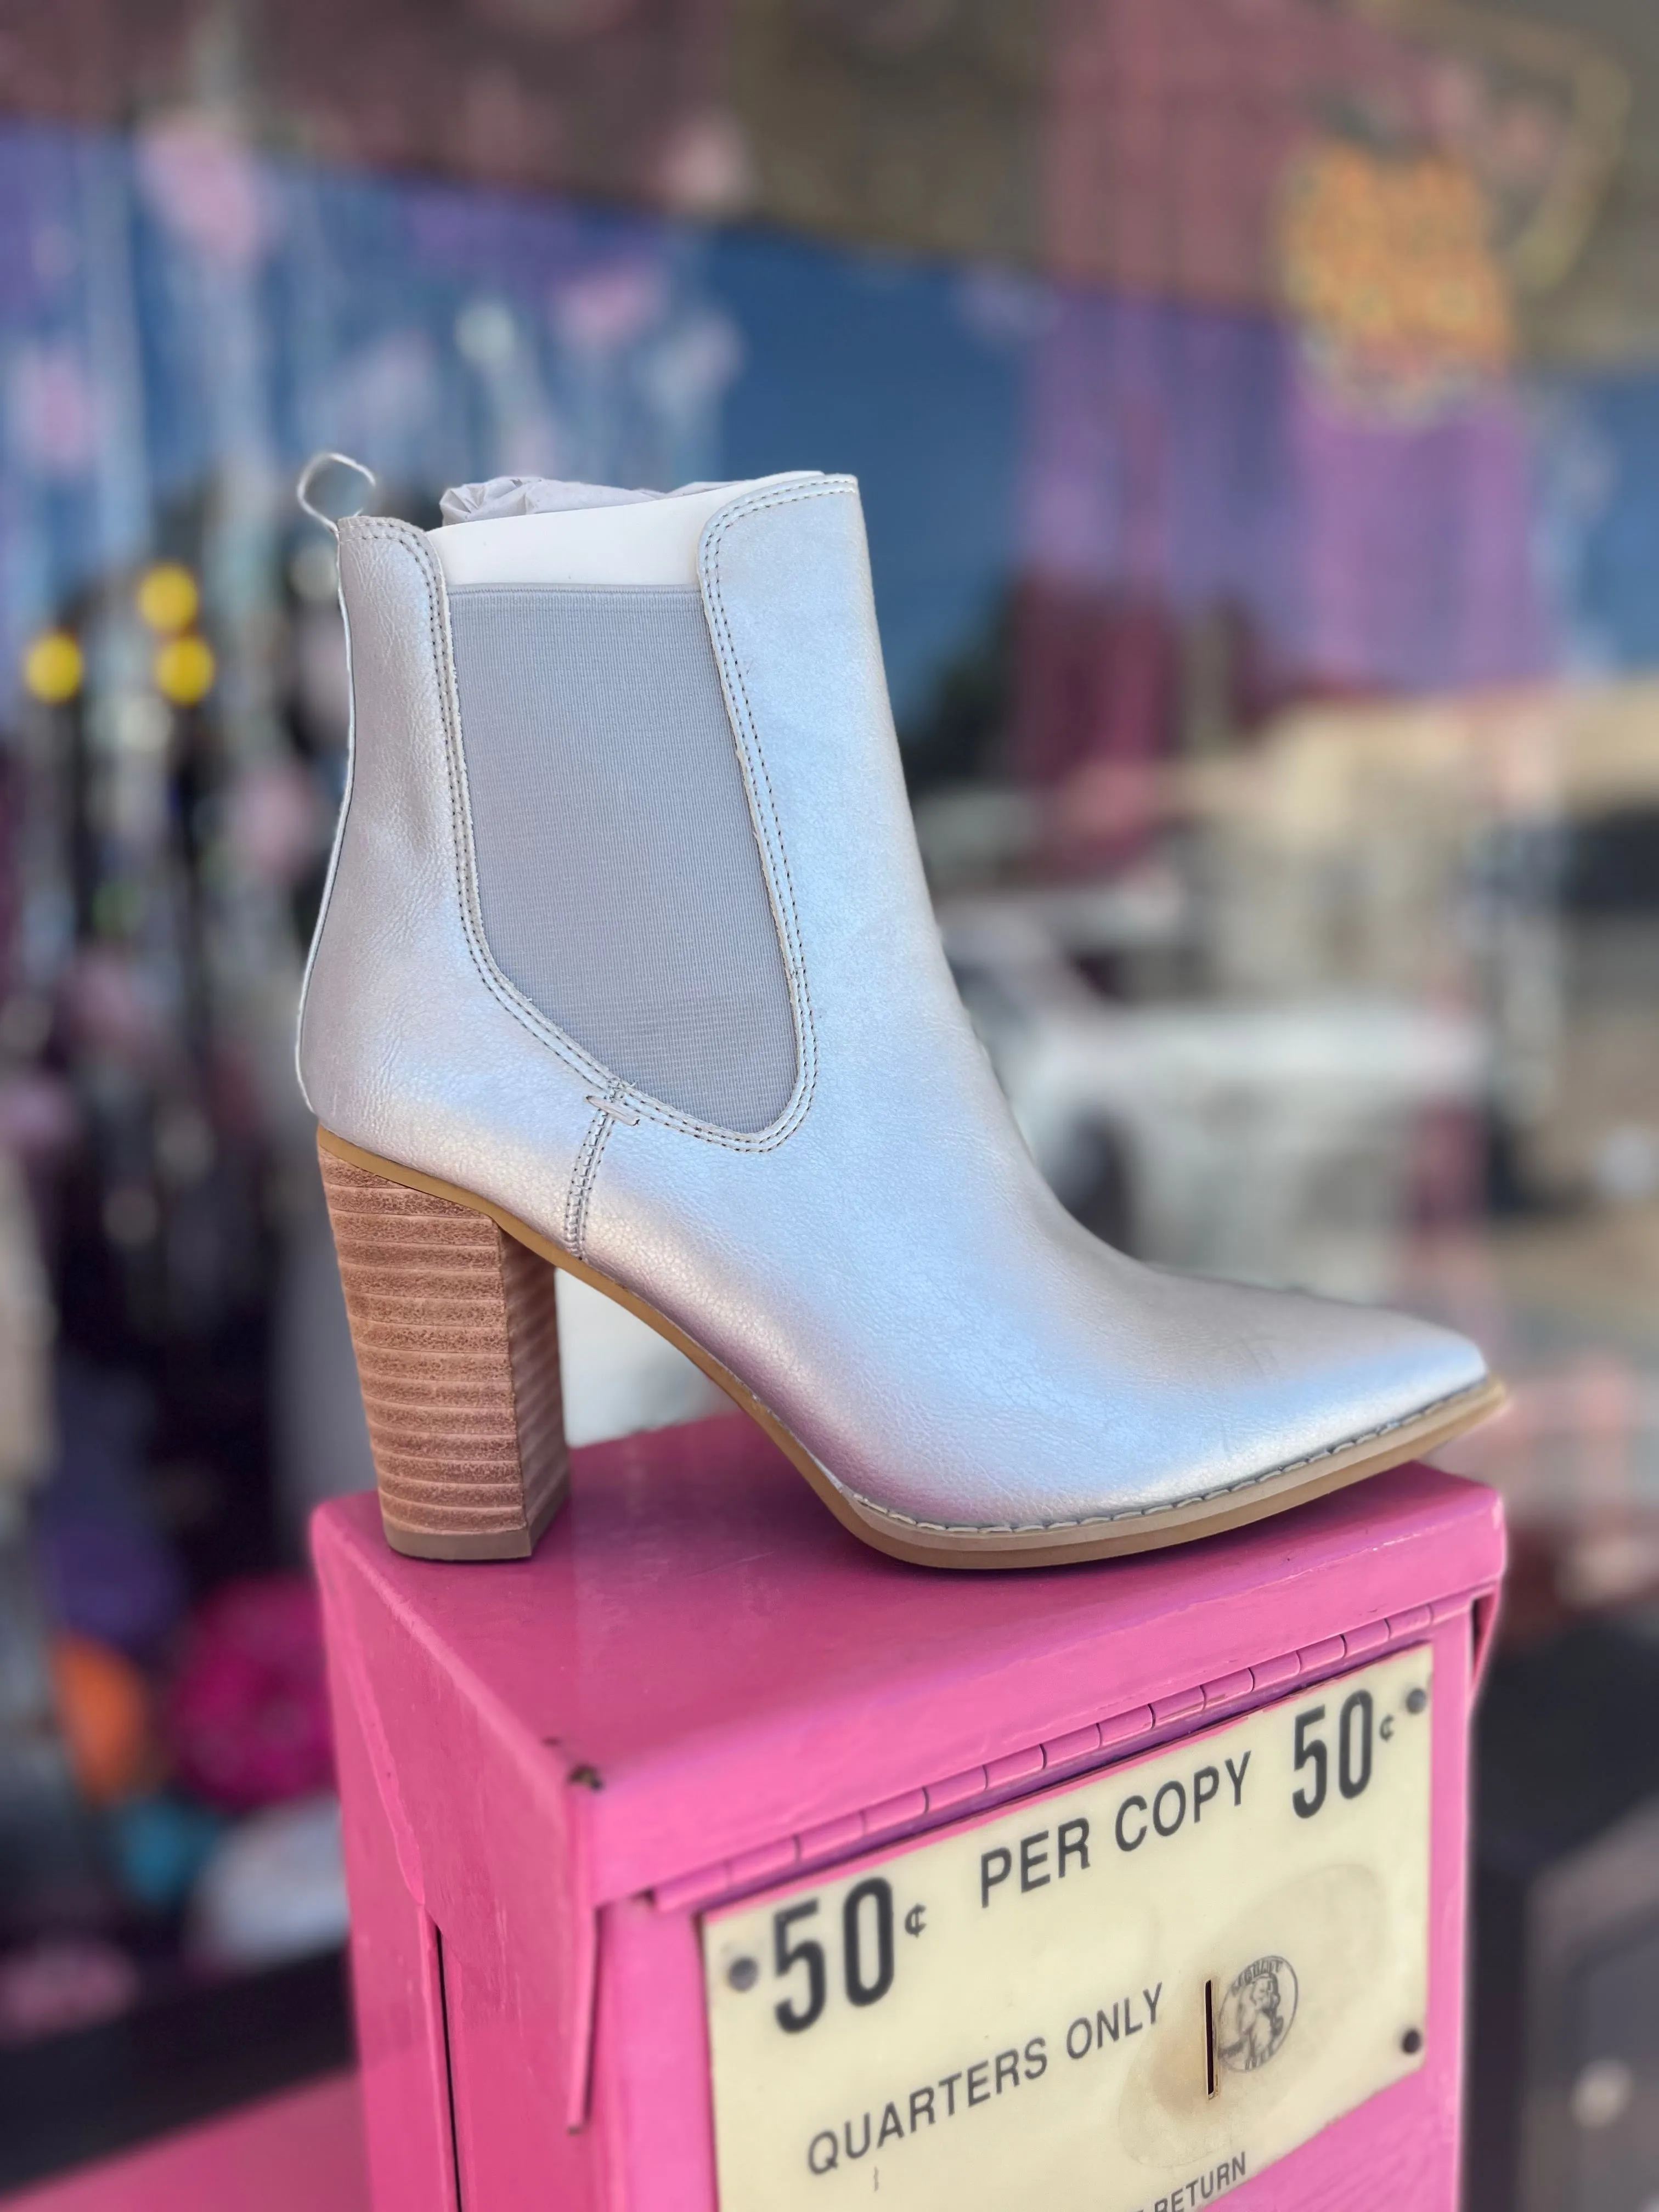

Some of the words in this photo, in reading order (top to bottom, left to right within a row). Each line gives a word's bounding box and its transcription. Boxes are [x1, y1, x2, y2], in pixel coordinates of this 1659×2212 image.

[980, 1816, 1091, 1909] PER
[1114, 1750, 1252, 1853] COPY
[808, 2036, 1048, 2176] QUARTERS
[1065, 1982, 1163, 2061] ONLY
[1153, 2151, 1246, 2212] RETURN
